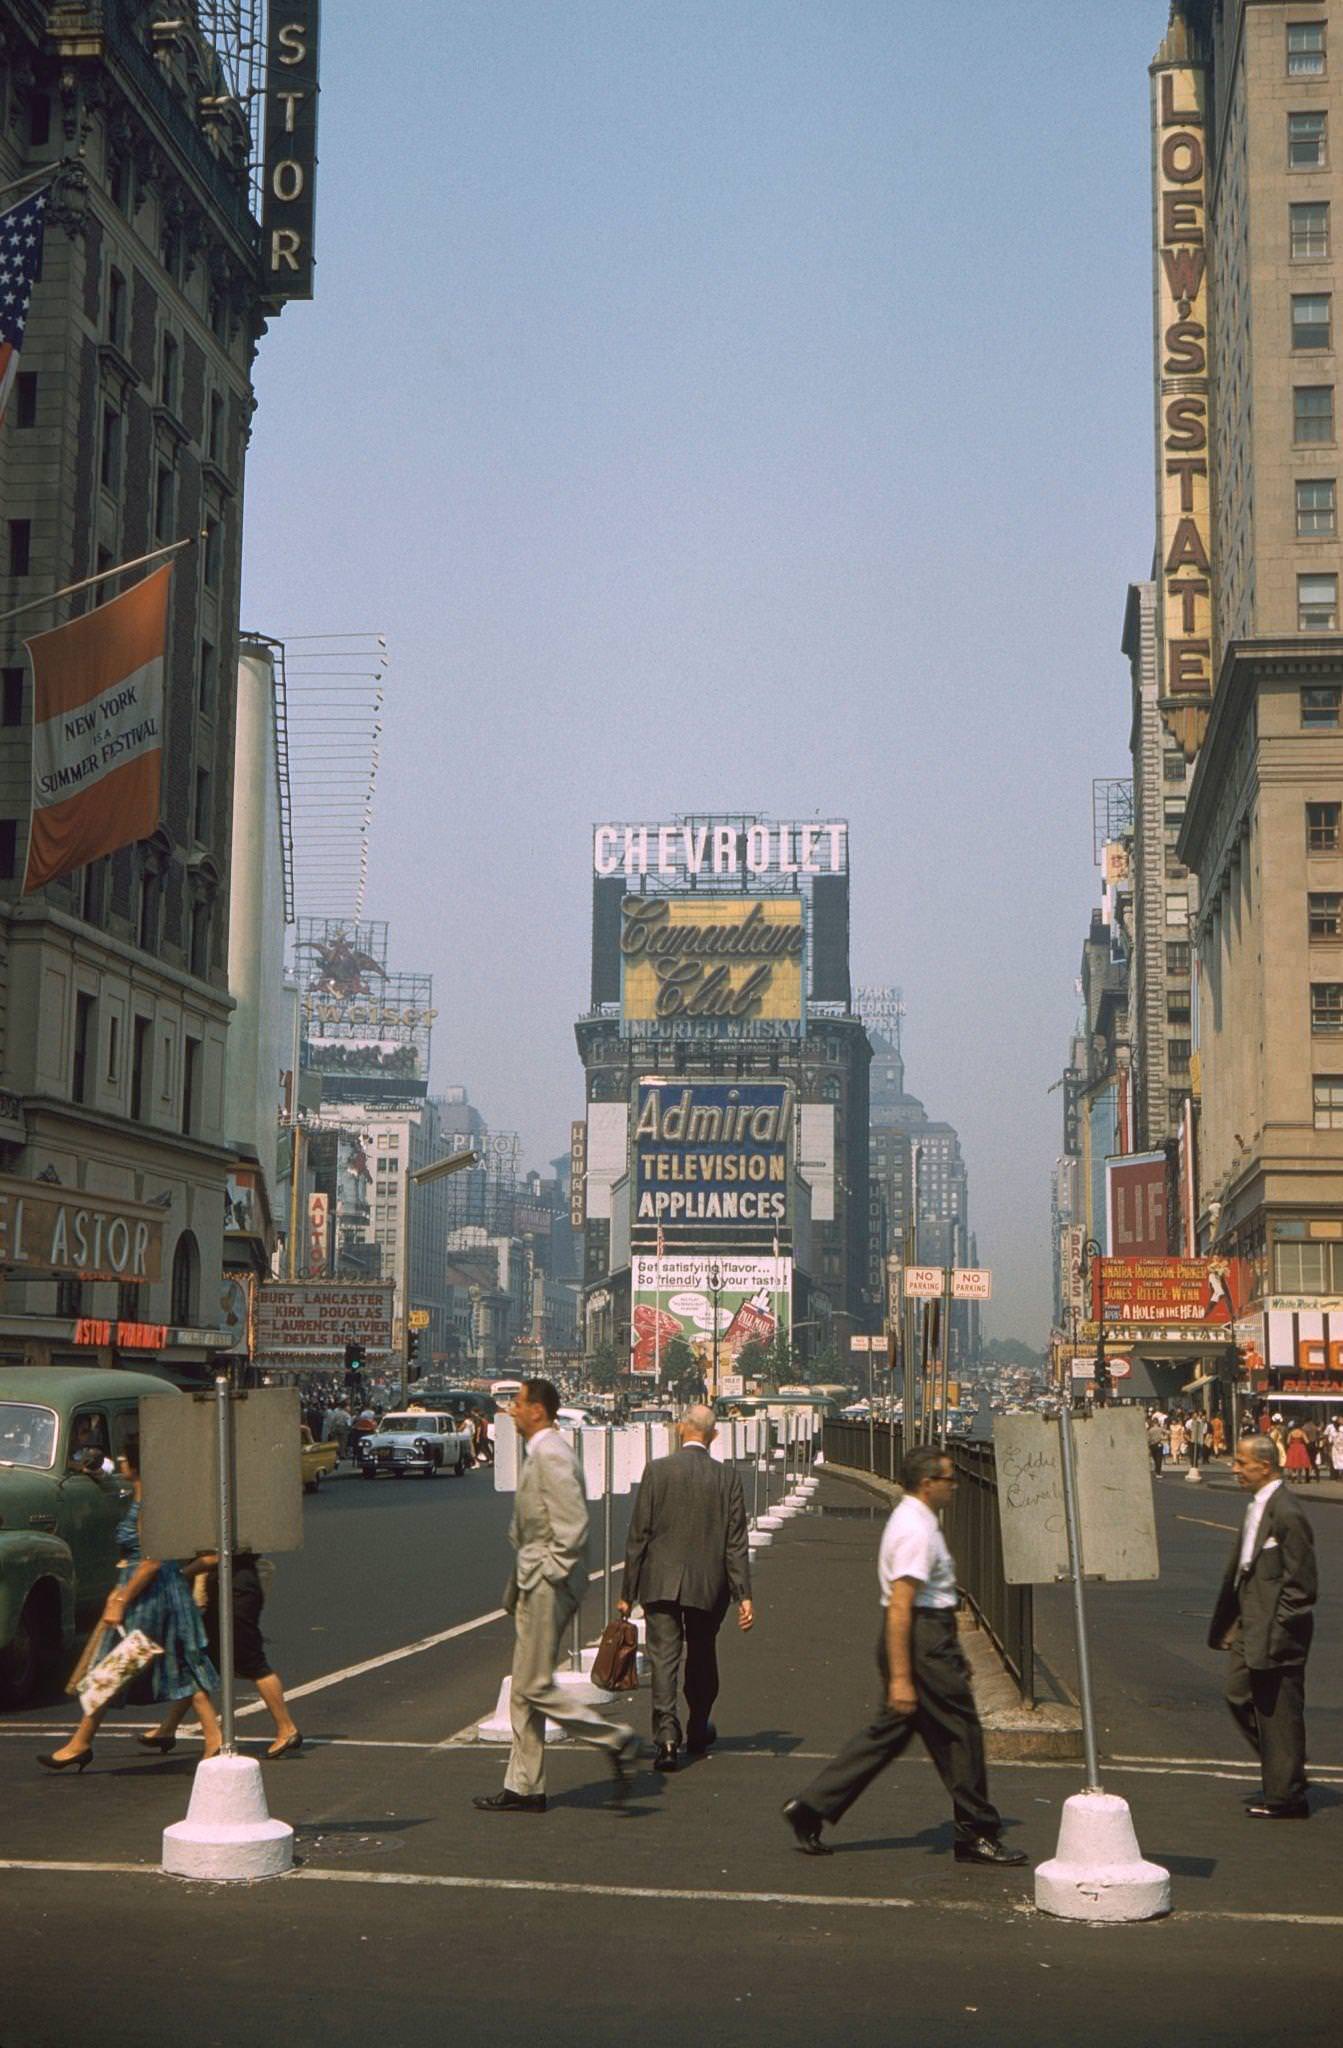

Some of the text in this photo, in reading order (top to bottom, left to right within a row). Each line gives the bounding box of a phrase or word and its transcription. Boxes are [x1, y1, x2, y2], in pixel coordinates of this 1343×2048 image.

[1158, 73, 1211, 696] LOEW'S STATE
[65, 686, 137, 741] NEW YORK
[92, 733, 102, 745] IS
[40, 718, 158, 794] SUMMER FESTIVAL
[594, 824, 847, 875] CHEVROLET
[619, 895, 806, 953] Canadian
[655, 956, 772, 1017] Club
[624, 1020, 799, 1038] IMPORTED WHISKY
[634, 1089, 794, 1144] Admiral
[571, 1127, 584, 1226] HOWARD
[641, 1153, 785, 1181] TELEVISION
[638, 1191, 785, 1219] APPLIANCES
[51, 1205, 149, 1276] ASTOR
[638, 1262, 658, 1273] Get
[662, 1261, 720, 1275] satisfying
[916, 1272, 934, 1281] NO
[962, 1274, 980, 1283] NO
[1070, 1233, 1083, 1298] BRASS
[638, 1275, 653, 1285] So
[721, 1278, 748, 1289] your
[909, 1281, 940, 1291] PARKING
[956, 1284, 986, 1293] PARKING
[275, 1306, 383, 1318] KIRK DOUGLAS
[305, 1294, 384, 1306] LANCASTER
[1122, 1304, 1131, 1319] A
[1132, 1304, 1156, 1320] HOLE
[1165, 1307, 1180, 1319] THE
[1180, 1304, 1206, 1320] HEAD
[74, 1318, 111, 1346] ASTOR
[117, 1320, 168, 1349] PHARMACY
[273, 1320, 338, 1332] LAURENCE
